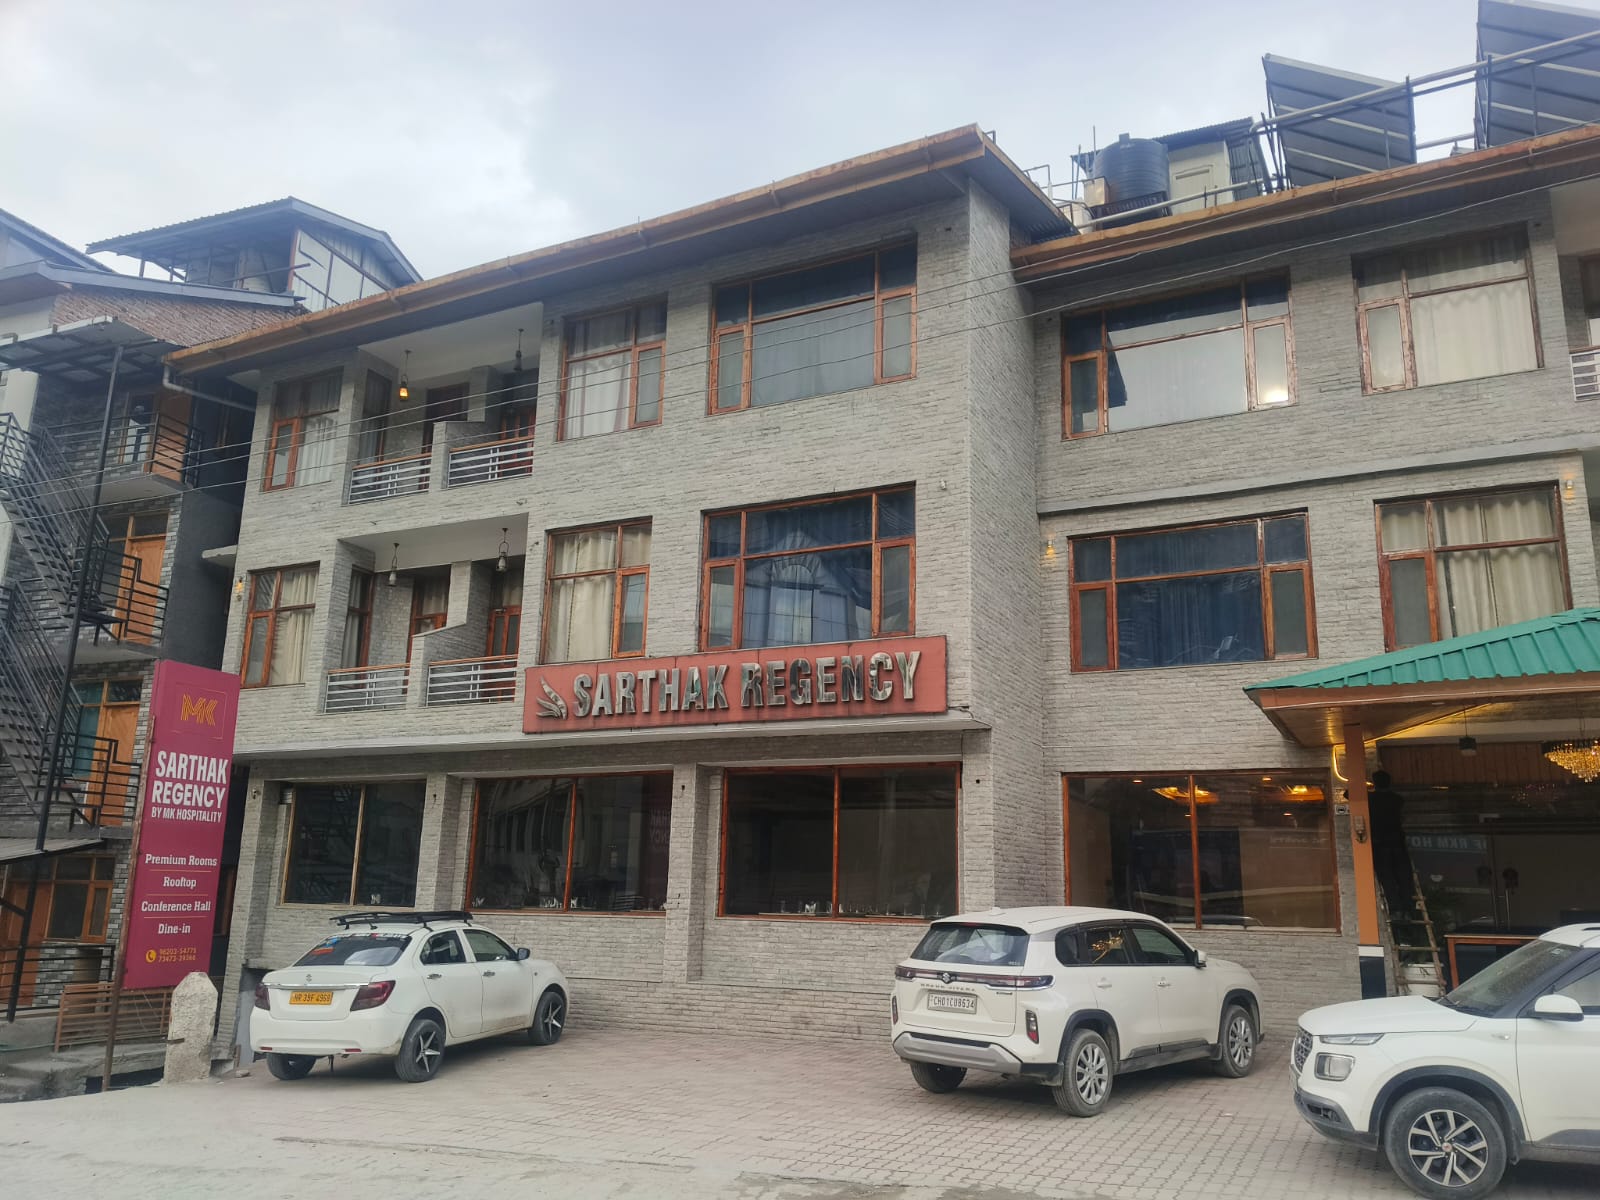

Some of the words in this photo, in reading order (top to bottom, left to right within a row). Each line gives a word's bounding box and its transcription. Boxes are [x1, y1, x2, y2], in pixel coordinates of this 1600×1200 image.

[573, 664, 729, 717] SARTHAK
[741, 650, 921, 706] REGENCY
[181, 693, 218, 726] MK
[155, 751, 228, 784] SARTHAK
[152, 780, 226, 808] REGENCY
[152, 806, 161, 818] BY
[163, 807, 175, 819] MK
[176, 809, 222, 823] HOSPITALITY
[145, 853, 187, 865] Premium
[188, 855, 217, 866] Rooms
[163, 876, 197, 889] Rooftop
[141, 901, 192, 912] Conference
[194, 901, 211, 911] Hall
[157, 923, 191, 934] Dine-in
